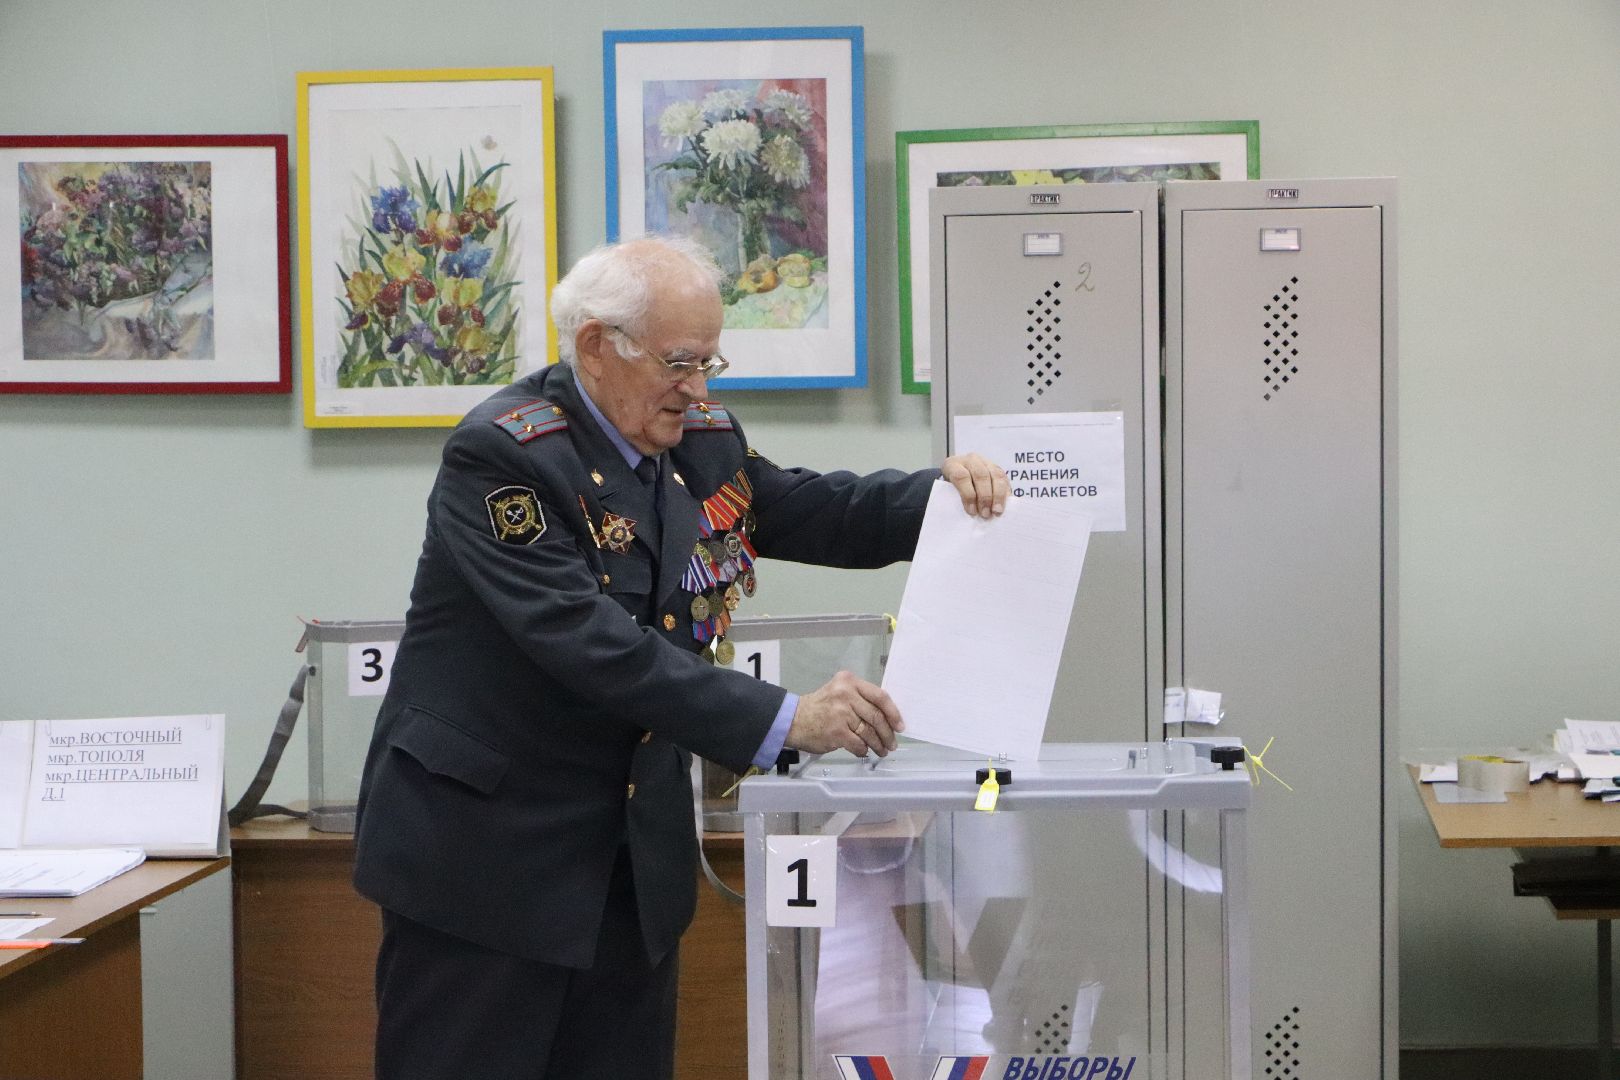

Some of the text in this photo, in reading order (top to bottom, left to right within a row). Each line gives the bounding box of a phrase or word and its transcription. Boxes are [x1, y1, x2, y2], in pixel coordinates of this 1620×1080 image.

[1074, 261, 1095, 292] 2
[1014, 451, 1065, 463] МЕСТО
[1010, 485, 1097, 498] Ф-ПАКЕТОВ
[361, 647, 384, 683] 3
[747, 652, 768, 683] 1
[50, 726, 182, 746] мкр.ВОСТОЧНЫЙ
[47, 749, 145, 764] мкр.ТОПОЛЯ
[45, 764, 199, 783] мкр.ЦЕНТРАЛЬНЫЙ
[787, 858, 817, 908] 1
[1002, 1056, 1137, 1080] ВЫБОРЫ
